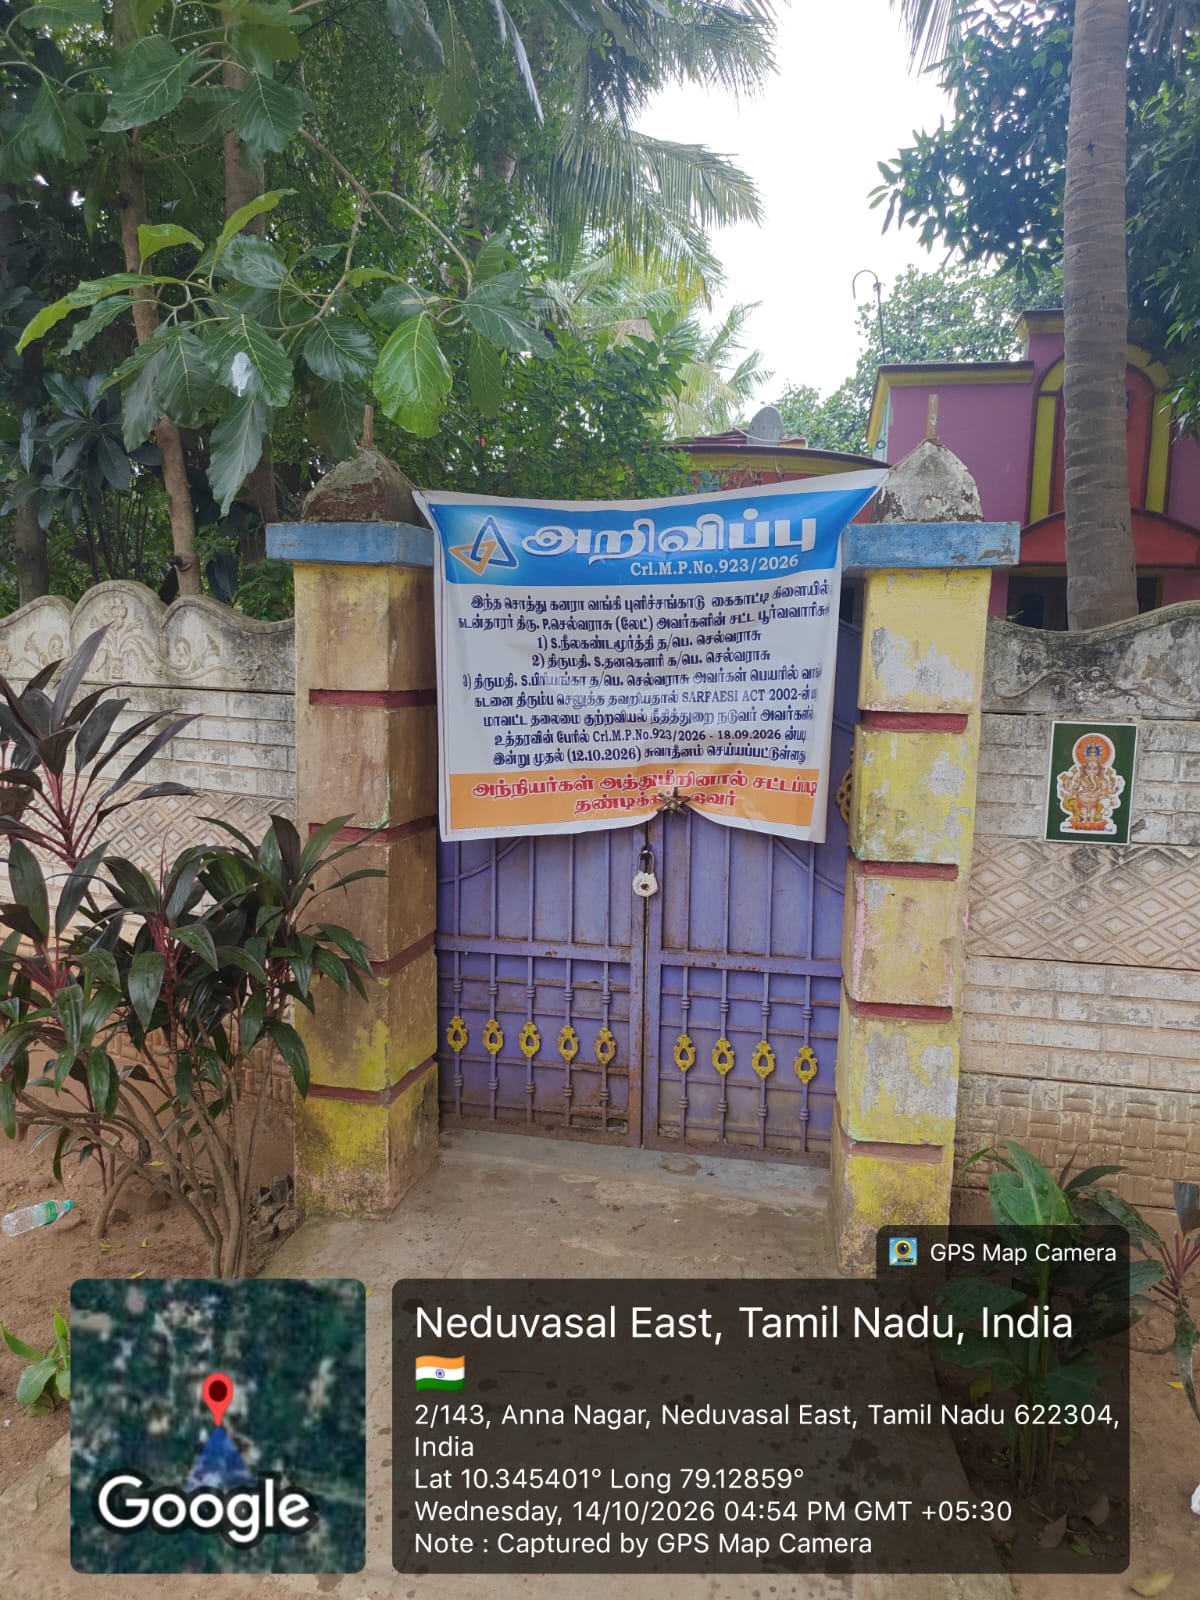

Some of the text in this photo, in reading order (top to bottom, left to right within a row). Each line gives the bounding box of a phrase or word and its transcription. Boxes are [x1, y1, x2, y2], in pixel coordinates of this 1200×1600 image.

[521, 508, 817, 564] அறிவிப்பு
[630, 554, 799, 577] Crl.M.P.No.923/2026
[471, 579, 831, 615] இந்த சொத்து கனரா வங்கி புளிச்சங்காடு கைகாட்டி கிளையில்
[516, 616, 540, 632] திரு.
[542, 616, 612, 632] P.செல்வராசு
[615, 614, 653, 633] (லேட்)
[656, 613, 726, 630] அவர்களின்
[730, 612, 755, 625] சட்ட
[758, 602, 830, 626] பூர்வவாரிசு
[537, 636, 548, 651] 1)
[657, 633, 692, 652] த/பெ.
[696, 629, 762, 647] செல்வராசு
[531, 654, 545, 669] 2)
[547, 654, 591, 670] திருமதி.
[667, 650, 702, 670] க/பெ.
[705, 647, 771, 664] செல்வராசு
[474, 673, 517, 690] திருமதி.
[589, 671, 623, 689] த/பெ.
[627, 671, 690, 687] செல்வராசு
[693, 666, 748, 683] அவர்கள்
[750, 664, 799, 682] பெயரில்
[474, 695, 513, 709] கடனை
[516, 691, 554, 709] திரும்ப
[556, 691, 605, 711] செலுத்த
[607, 690, 679, 708] தவறியதால்
[682, 689, 738, 704] SARFAESI
[742, 688, 766, 702] ACT
[483, 714, 528, 728] மாவட்ட
[530, 714, 581, 728] தலைமை
[584, 709, 648, 728] குற்றவியல்
[650, 706, 715, 727] நீதித்துறை
[716, 705, 757, 725] நடுவர்
[494, 729, 554, 748] உத்தரவின்
[557, 730, 589, 745] பேரில்
[592, 728, 706, 743] Crl.M.P.No.923/2026
[717, 728, 782, 741] 18.09.2026
[493, 750, 530, 768] இன்று
[533, 750, 565, 766] முதல்
[567, 745, 642, 764] (12.10.2026)
[644, 743, 704, 760] சுவாதீனம்
[472, 774, 595, 798] அந்நியர்கள்
[599, 769, 748, 793] அத்துமீறினால்
[575, 790, 737, 815] தண்டிக்கடுவர்
